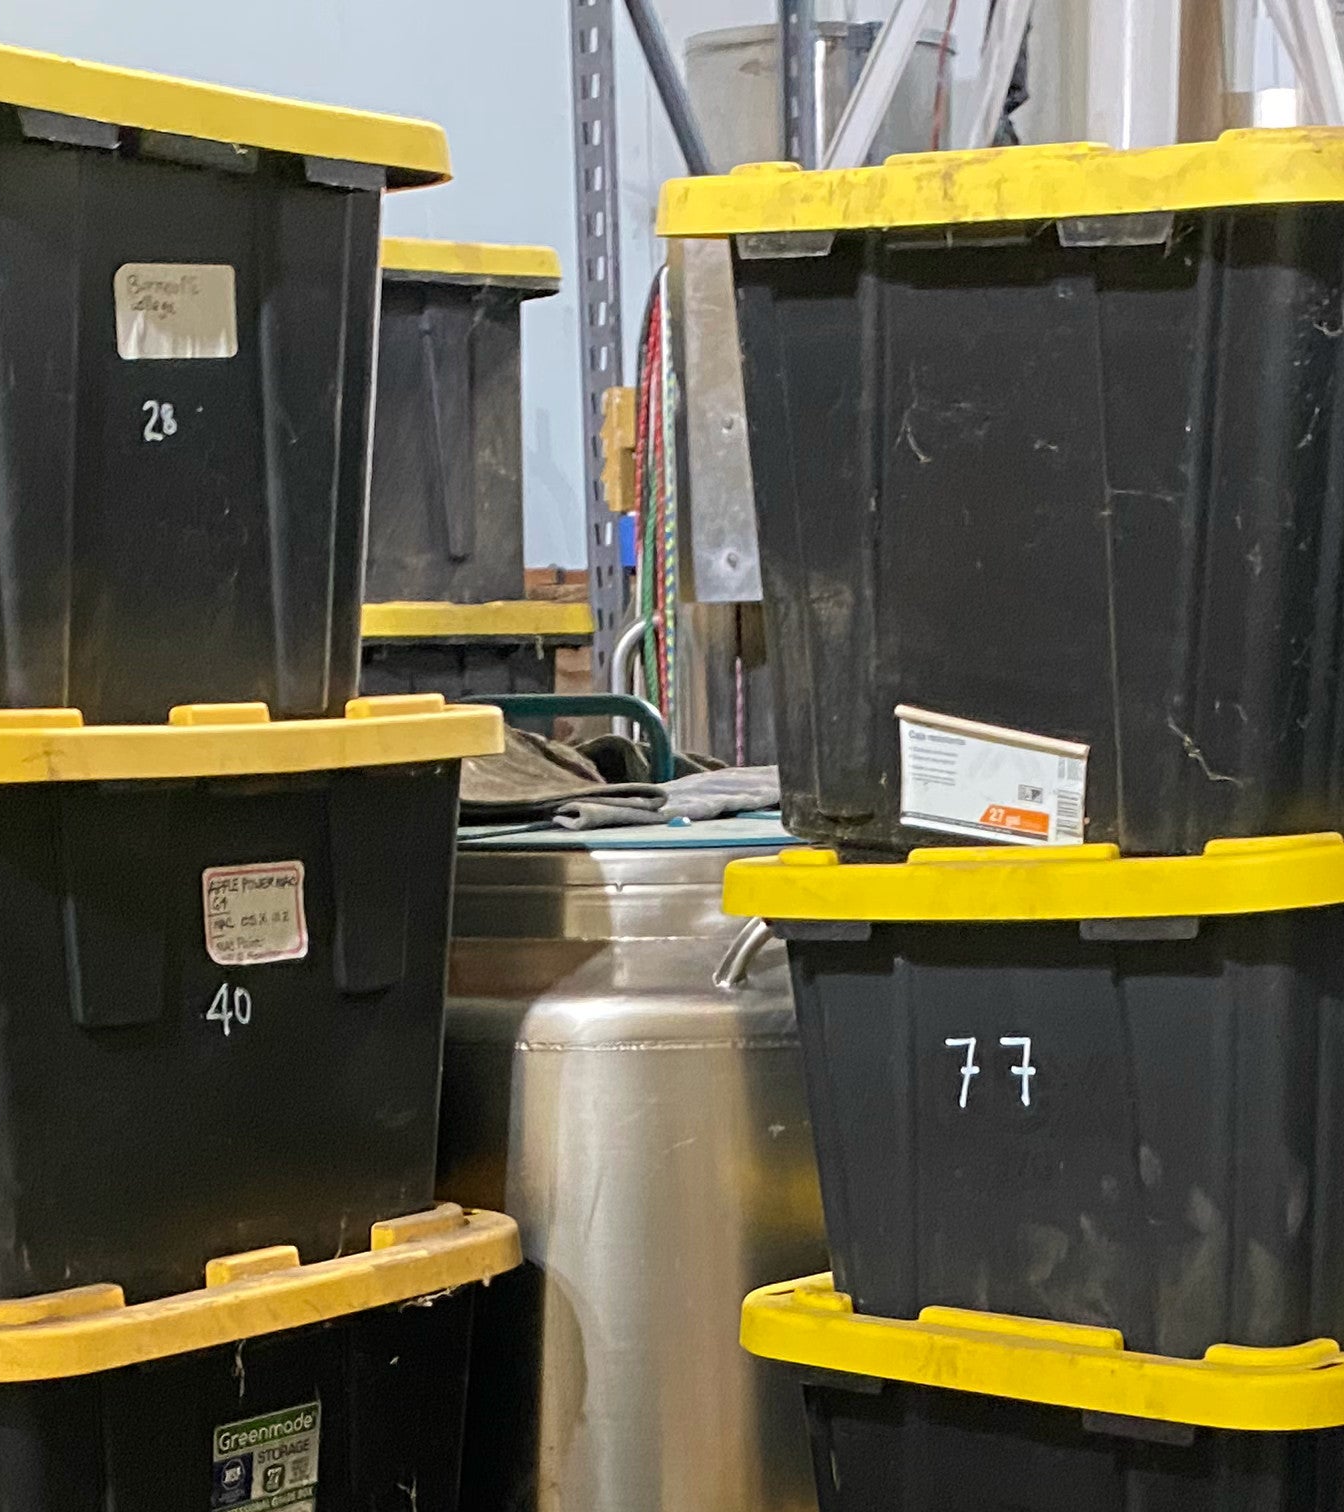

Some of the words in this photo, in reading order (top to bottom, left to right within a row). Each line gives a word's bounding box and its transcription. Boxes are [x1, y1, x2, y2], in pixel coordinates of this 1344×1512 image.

[143, 400, 178, 442] 28
[206, 982, 252, 1036] 40
[945, 1036, 1036, 1108] 77
[256, 1439, 311, 1464] STORAGE
